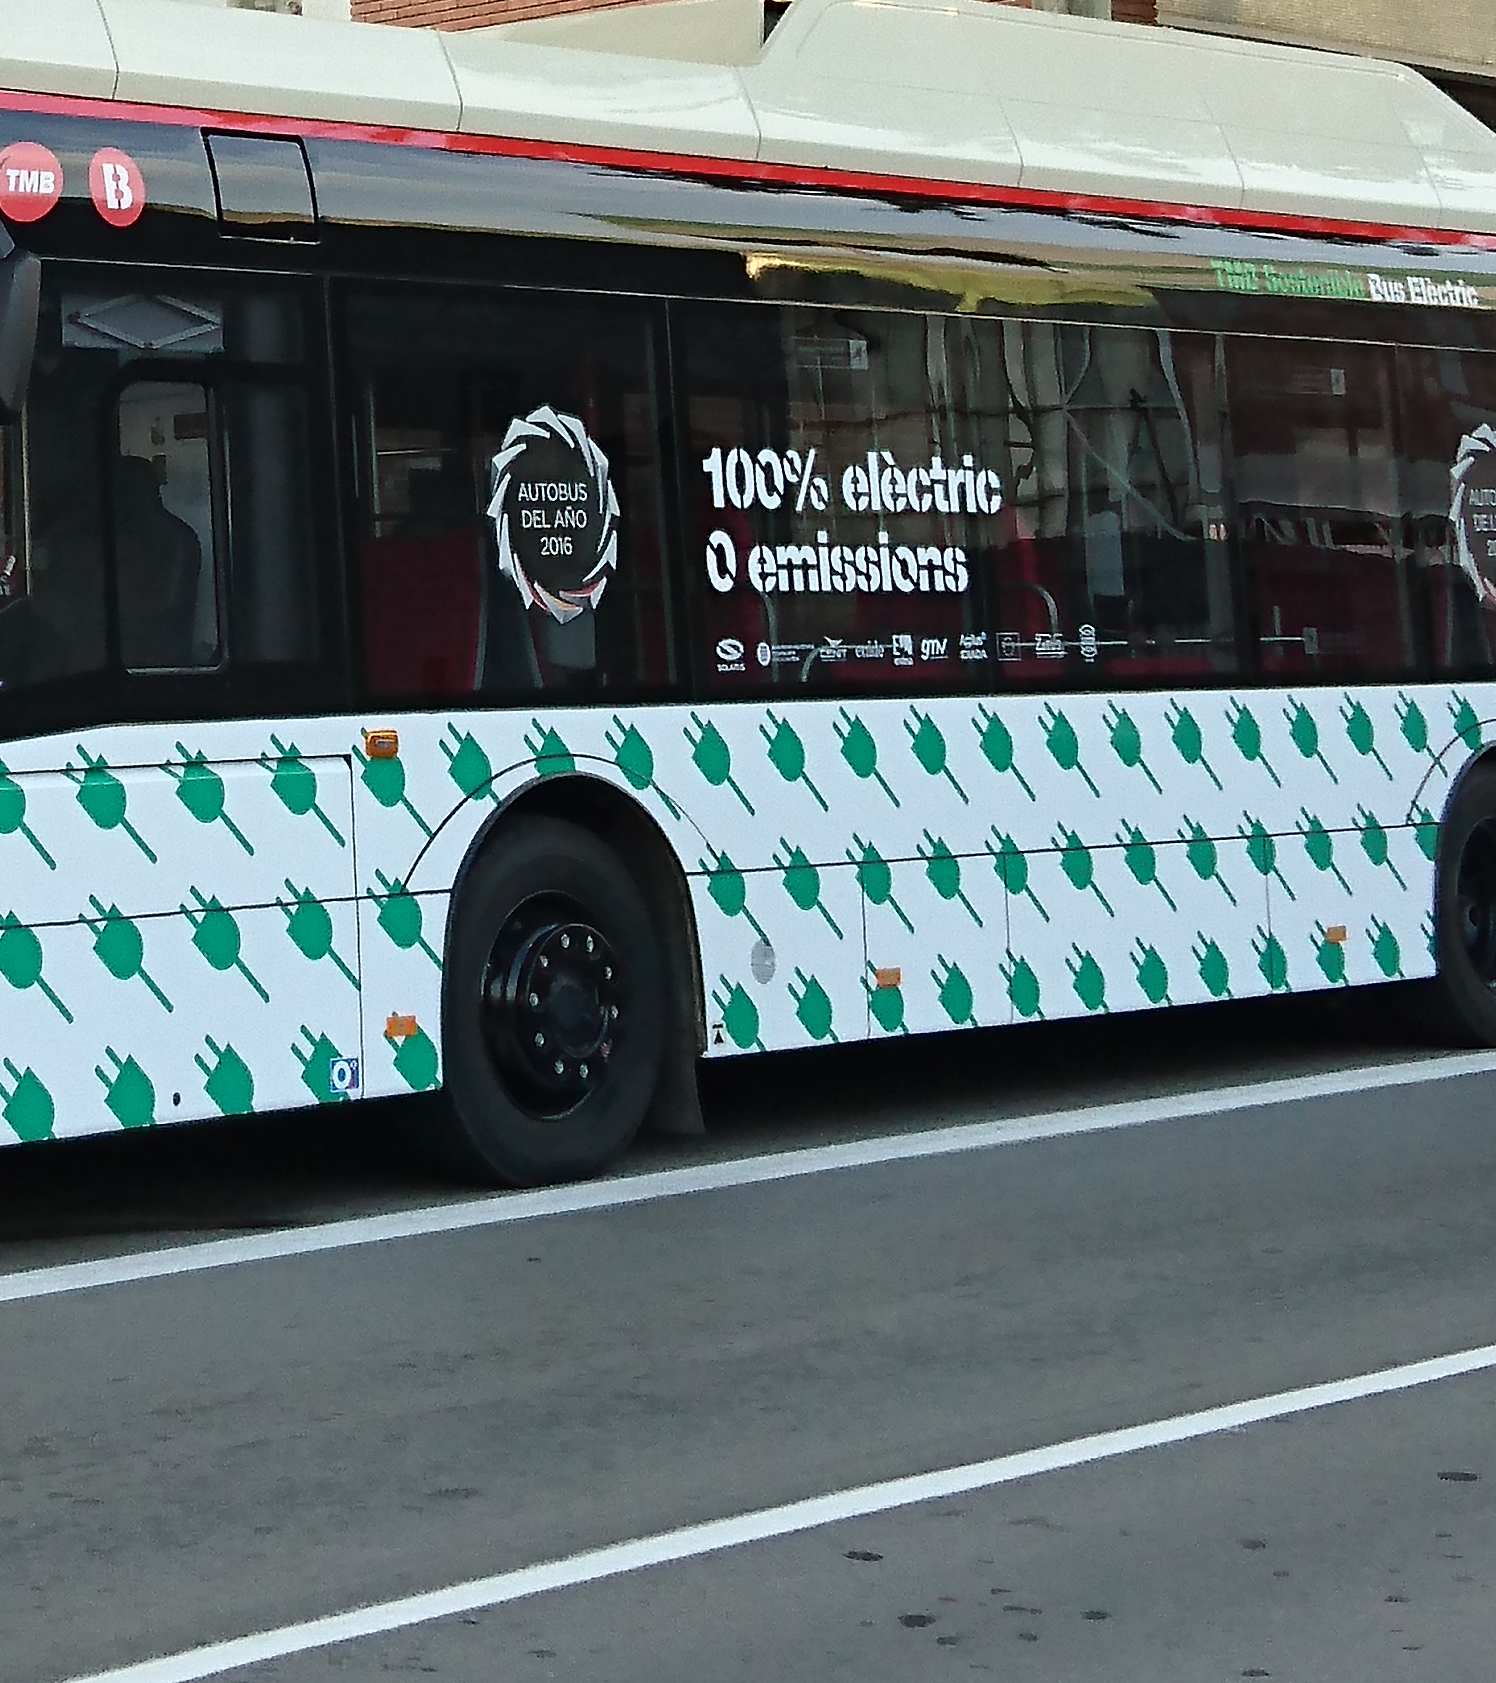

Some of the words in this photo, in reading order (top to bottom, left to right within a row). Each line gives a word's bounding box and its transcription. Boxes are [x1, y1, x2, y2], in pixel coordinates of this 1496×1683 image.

[6, 169, 55, 194] TMB
[1367, 273, 1405, 302] Bus
[518, 482, 588, 502] AUTOBUS
[703, 447, 829, 512] 100%
[842, 450, 1002, 514] elèctric
[521, 510, 551, 528] DEL
[554, 506, 587, 529] AÑO
[540, 536, 573, 555] 2016
[706, 530, 736, 592] 0
[748, 530, 969, 592] emissions
